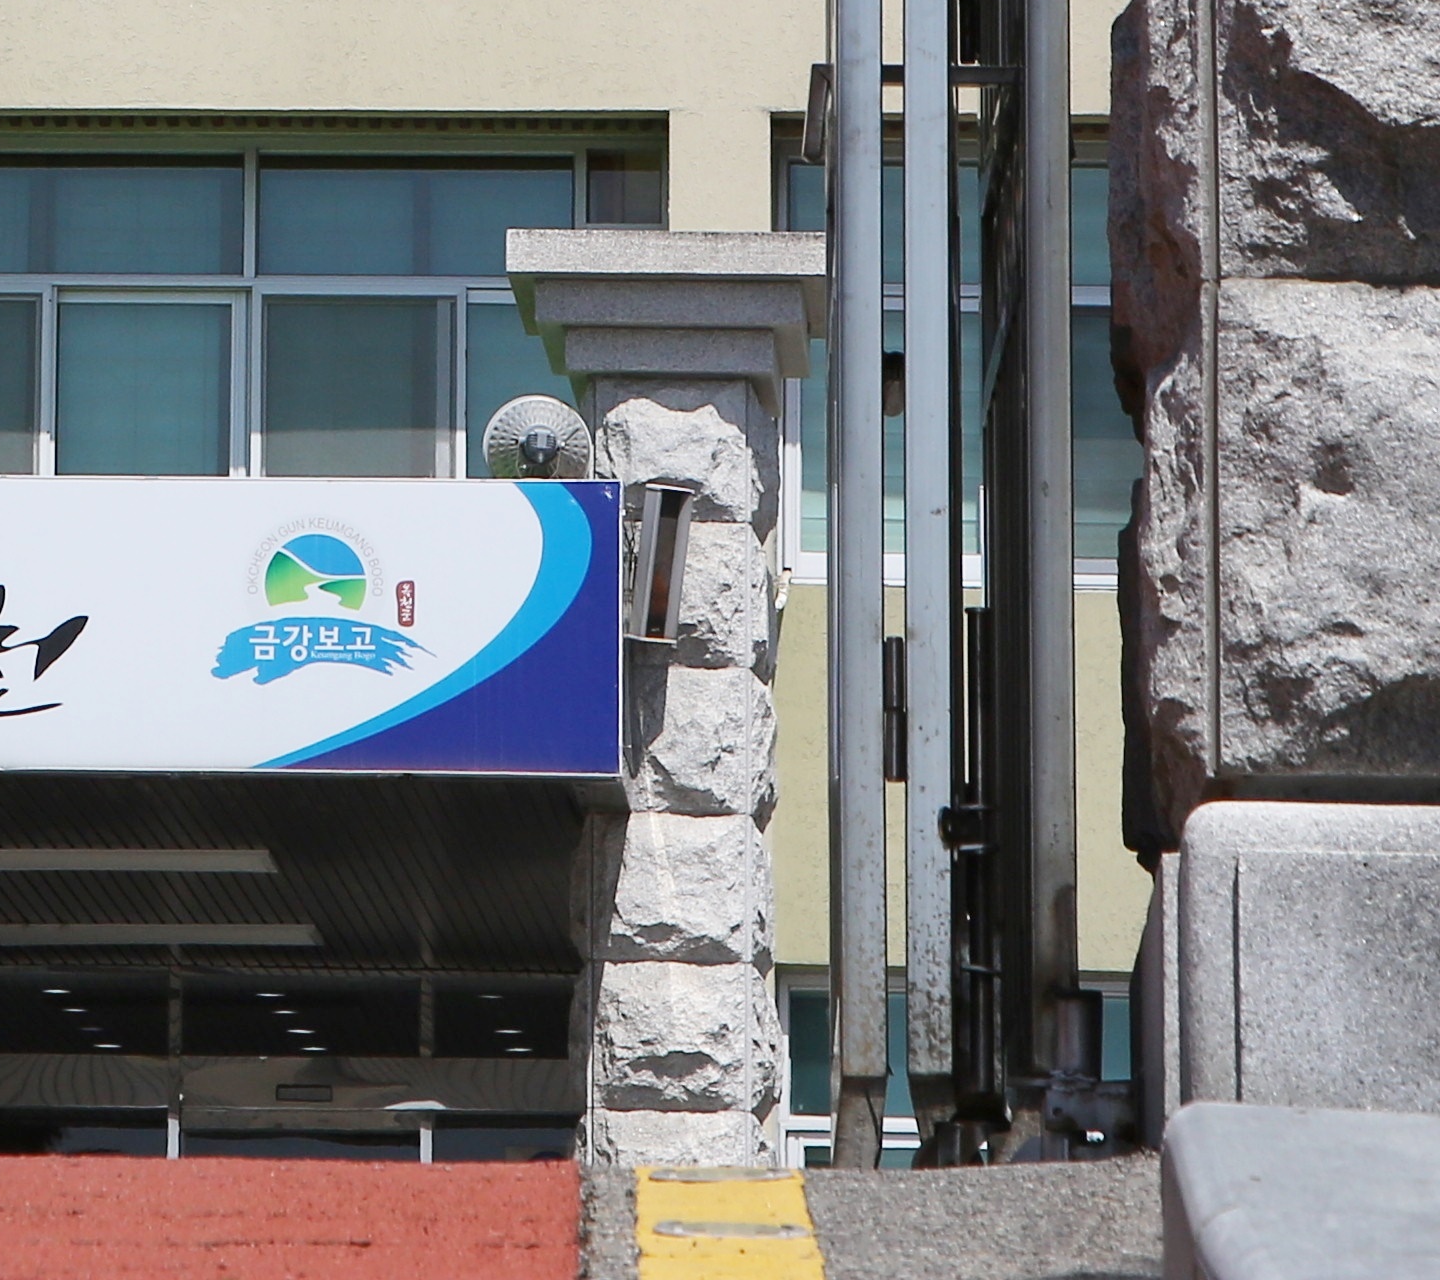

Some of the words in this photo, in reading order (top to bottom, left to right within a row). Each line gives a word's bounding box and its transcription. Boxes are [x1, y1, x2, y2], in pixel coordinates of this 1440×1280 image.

[247, 534, 279, 595] OKCHEON
[278, 519, 306, 537] GUN
[308, 517, 375, 558] KEUMGANG
[368, 557, 384, 597] BOGO
[249, 625, 376, 661] 금강보고
